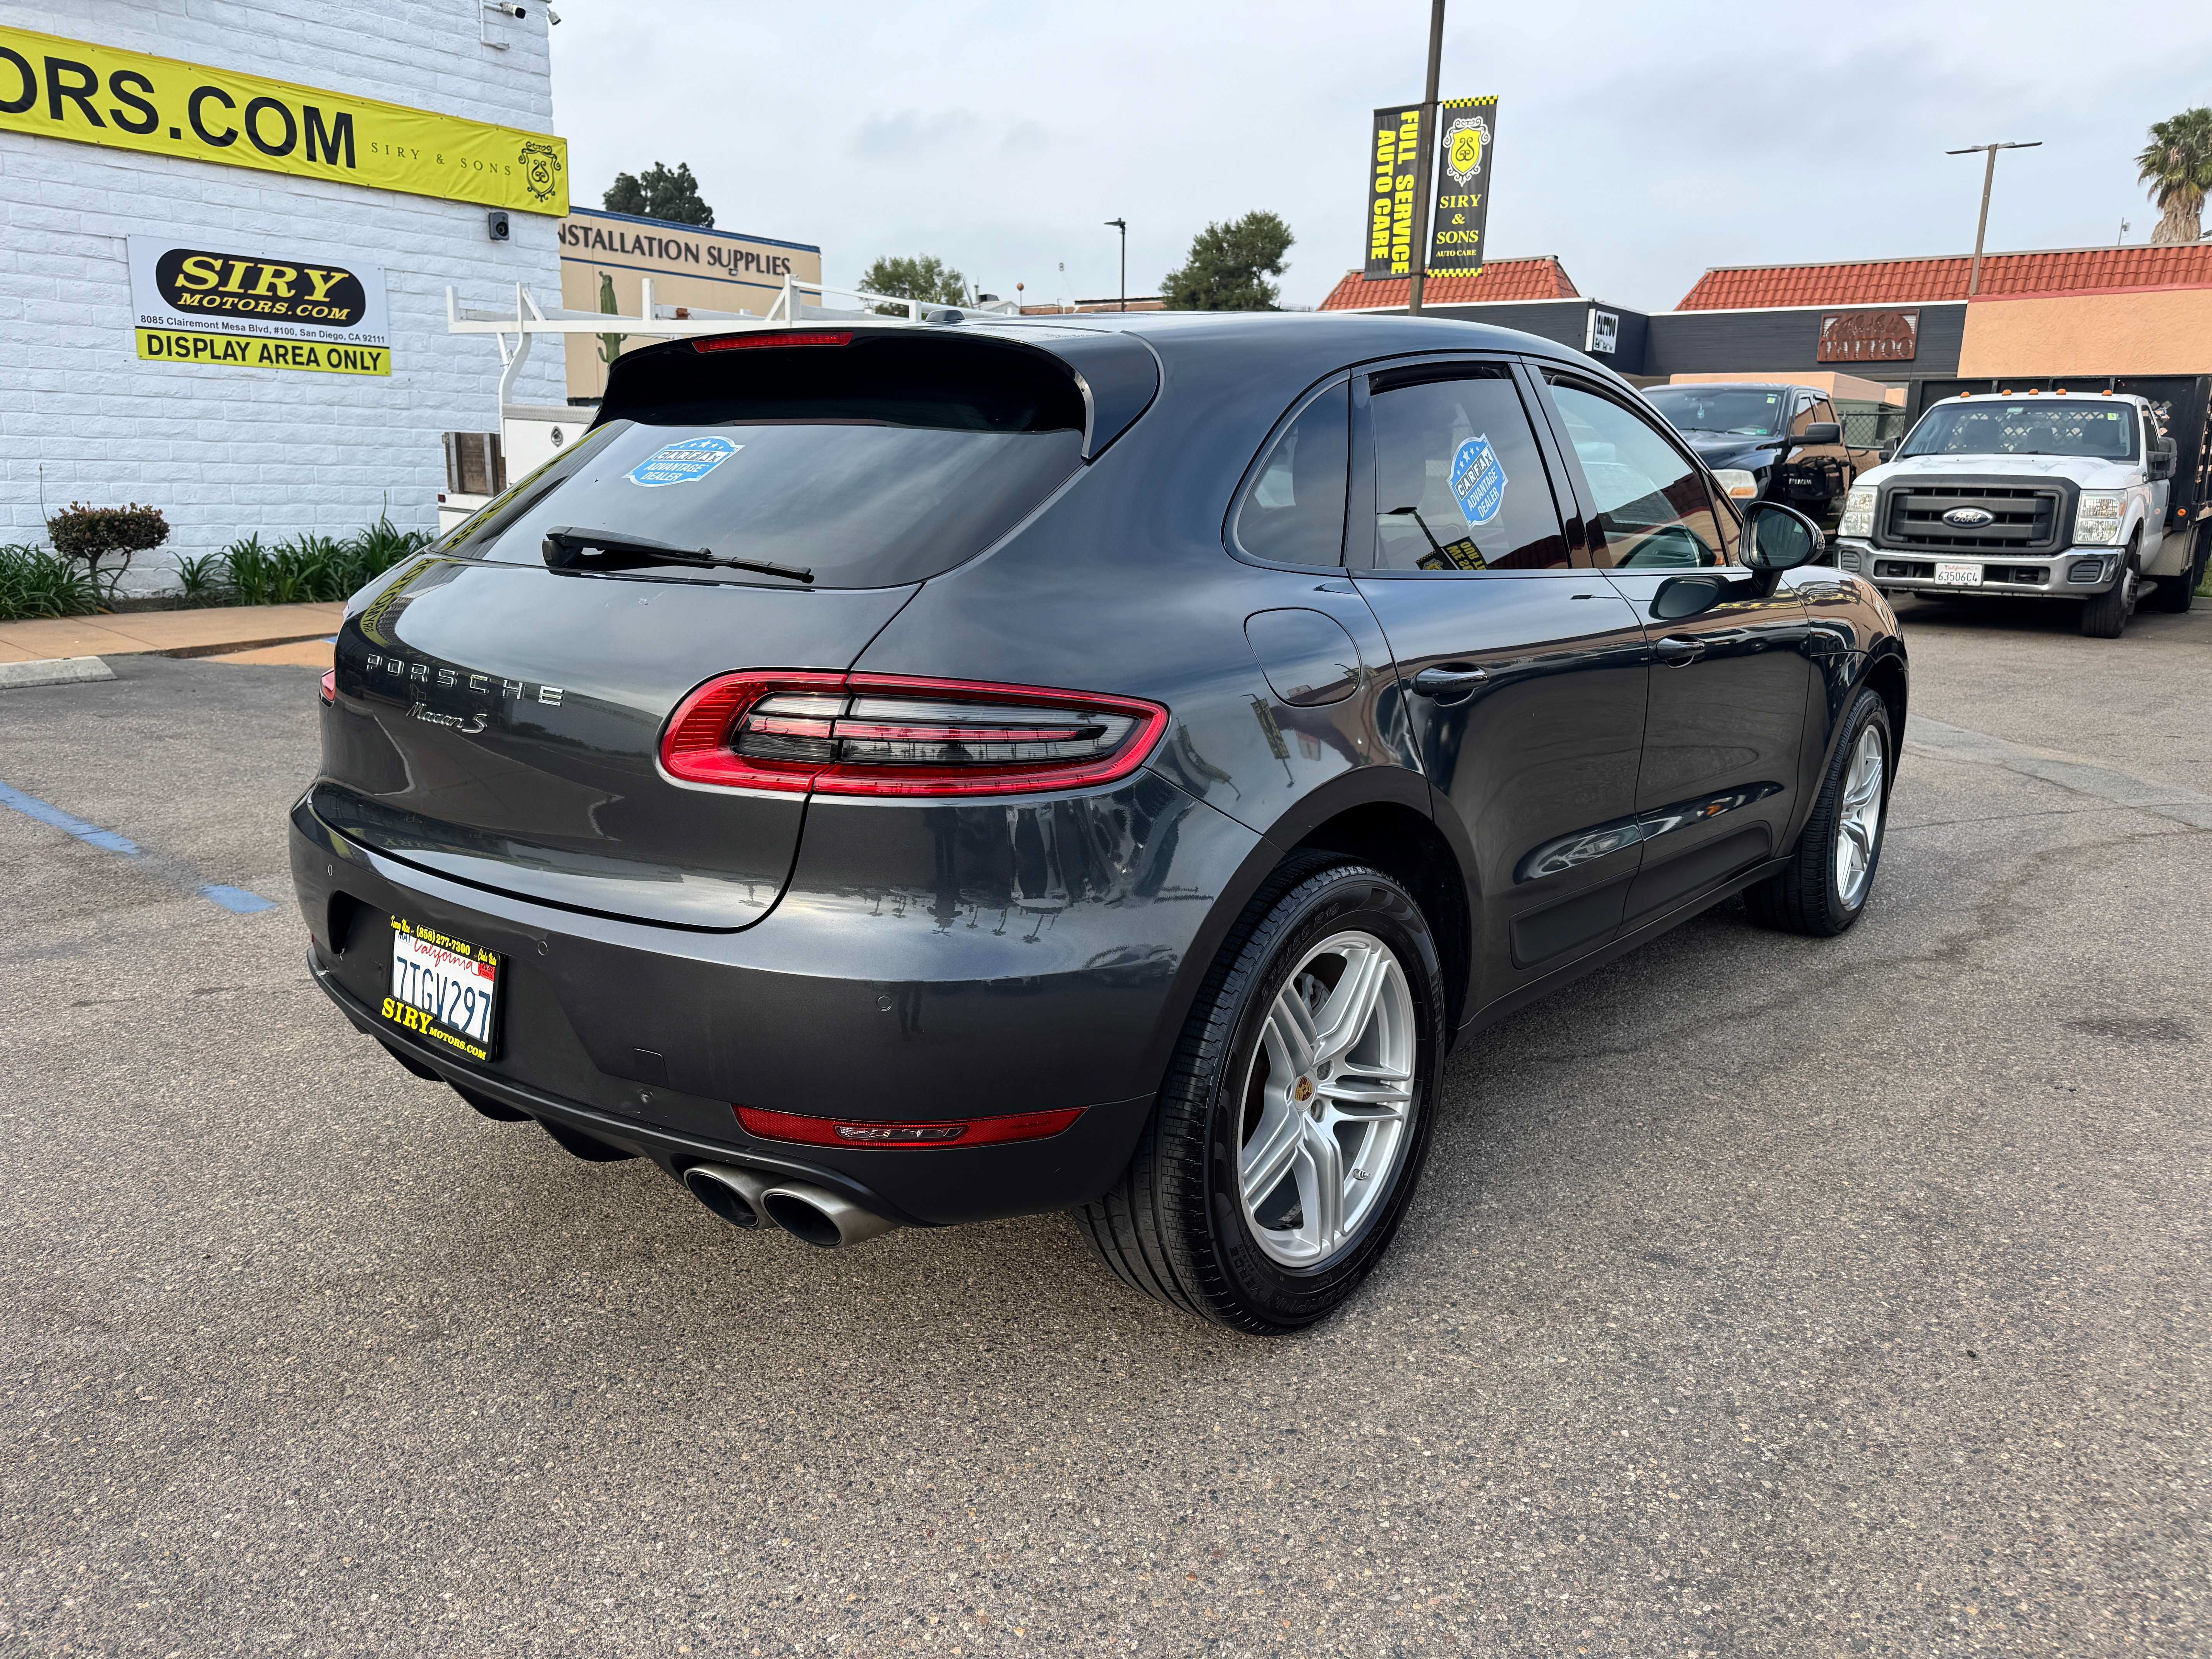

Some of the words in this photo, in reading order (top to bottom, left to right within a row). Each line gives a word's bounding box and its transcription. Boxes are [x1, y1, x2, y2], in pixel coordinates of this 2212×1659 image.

[0, 46, 356, 169] ORS.COM
[1397, 110, 1419, 165] FULL
[371, 142, 420, 160] SIRY
[436, 153, 445, 165] &
[460, 158, 512, 176] SONS
[1375, 130, 1396, 193] AUTO
[1439, 194, 1482, 209] SIRY
[1371, 198, 1391, 260] CARE
[1391, 173, 1414, 275] SERVICE
[1451, 213, 1465, 225] &
[1436, 230, 1479, 244] SONS
[707, 246, 791, 276] SUPPLIES
[174, 256, 349, 302] SIRY
[177, 293, 351, 320] MOTORS.COM
[141, 315, 163, 324] 8085
[167, 317, 219, 329] Clairemont
[222, 322, 246, 331] Mesa
[249, 324, 272, 335] Blvd,
[274, 327, 297, 337] #100,
[300, 329, 316, 337] San
[319, 330, 346, 341] Diego,
[348, 333, 361, 341] CA
[362, 335, 385, 343] 92111
[1597, 315, 1616, 337] TATTOO
[147, 334, 251, 362] DISPLAY
[258, 343, 321, 367] AREA
[327, 348, 382, 371] ONLY
[1821, 337, 1913, 359] TATTOO
[644, 462, 704, 473] ADVANTAGE
[656, 451, 726, 463] CARFAX
[1457, 451, 1494, 496] CARFAX
[640, 472, 683, 481] DEALER
[1467, 468, 1498, 511] ADVANTAGE
[1477, 486, 1500, 519] DEALER
[1953, 511, 1981, 522] Ford
[1938, 571, 1977, 582] 63506C4
[366, 654, 565, 707] PORSCHE
[406, 701, 465, 728] Macan
[462, 713, 489, 734] S
[416, 924, 435, 943] (858)
[436, 934, 471, 956] 277-7300
[414, 938, 481, 976] California
[397, 956, 490, 1041] 7TGV297
[381, 998, 433, 1035] SIRY
[429, 1026, 487, 1061] MOTORS.COM
